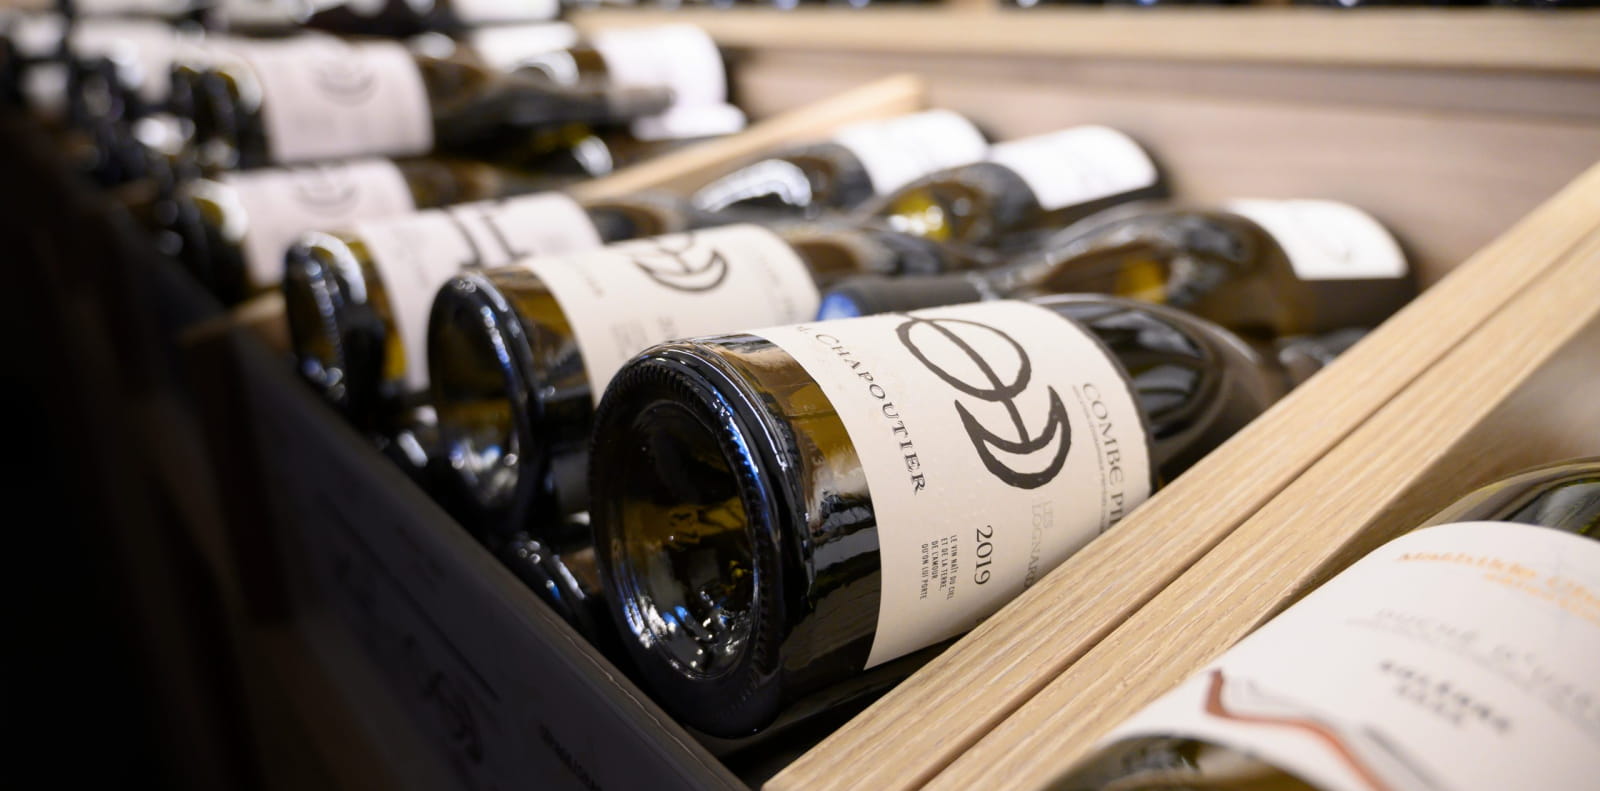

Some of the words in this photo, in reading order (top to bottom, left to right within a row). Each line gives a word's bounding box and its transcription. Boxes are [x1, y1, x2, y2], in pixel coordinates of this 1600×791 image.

[1082, 383, 1124, 485] COMBE
[941, 538, 948, 546] ET
[950, 534, 958, 543] LE
[931, 540, 939, 549] DE
[941, 547, 948, 557] DE
[950, 545, 958, 557] VIN
[974, 525, 993, 585] 2019
[941, 559, 948, 568] LA
[921, 566, 929, 578] LUI
[949, 575, 957, 585] DU
[919, 579, 929, 601] PORTE
[946, 586, 955, 601] CIEL
